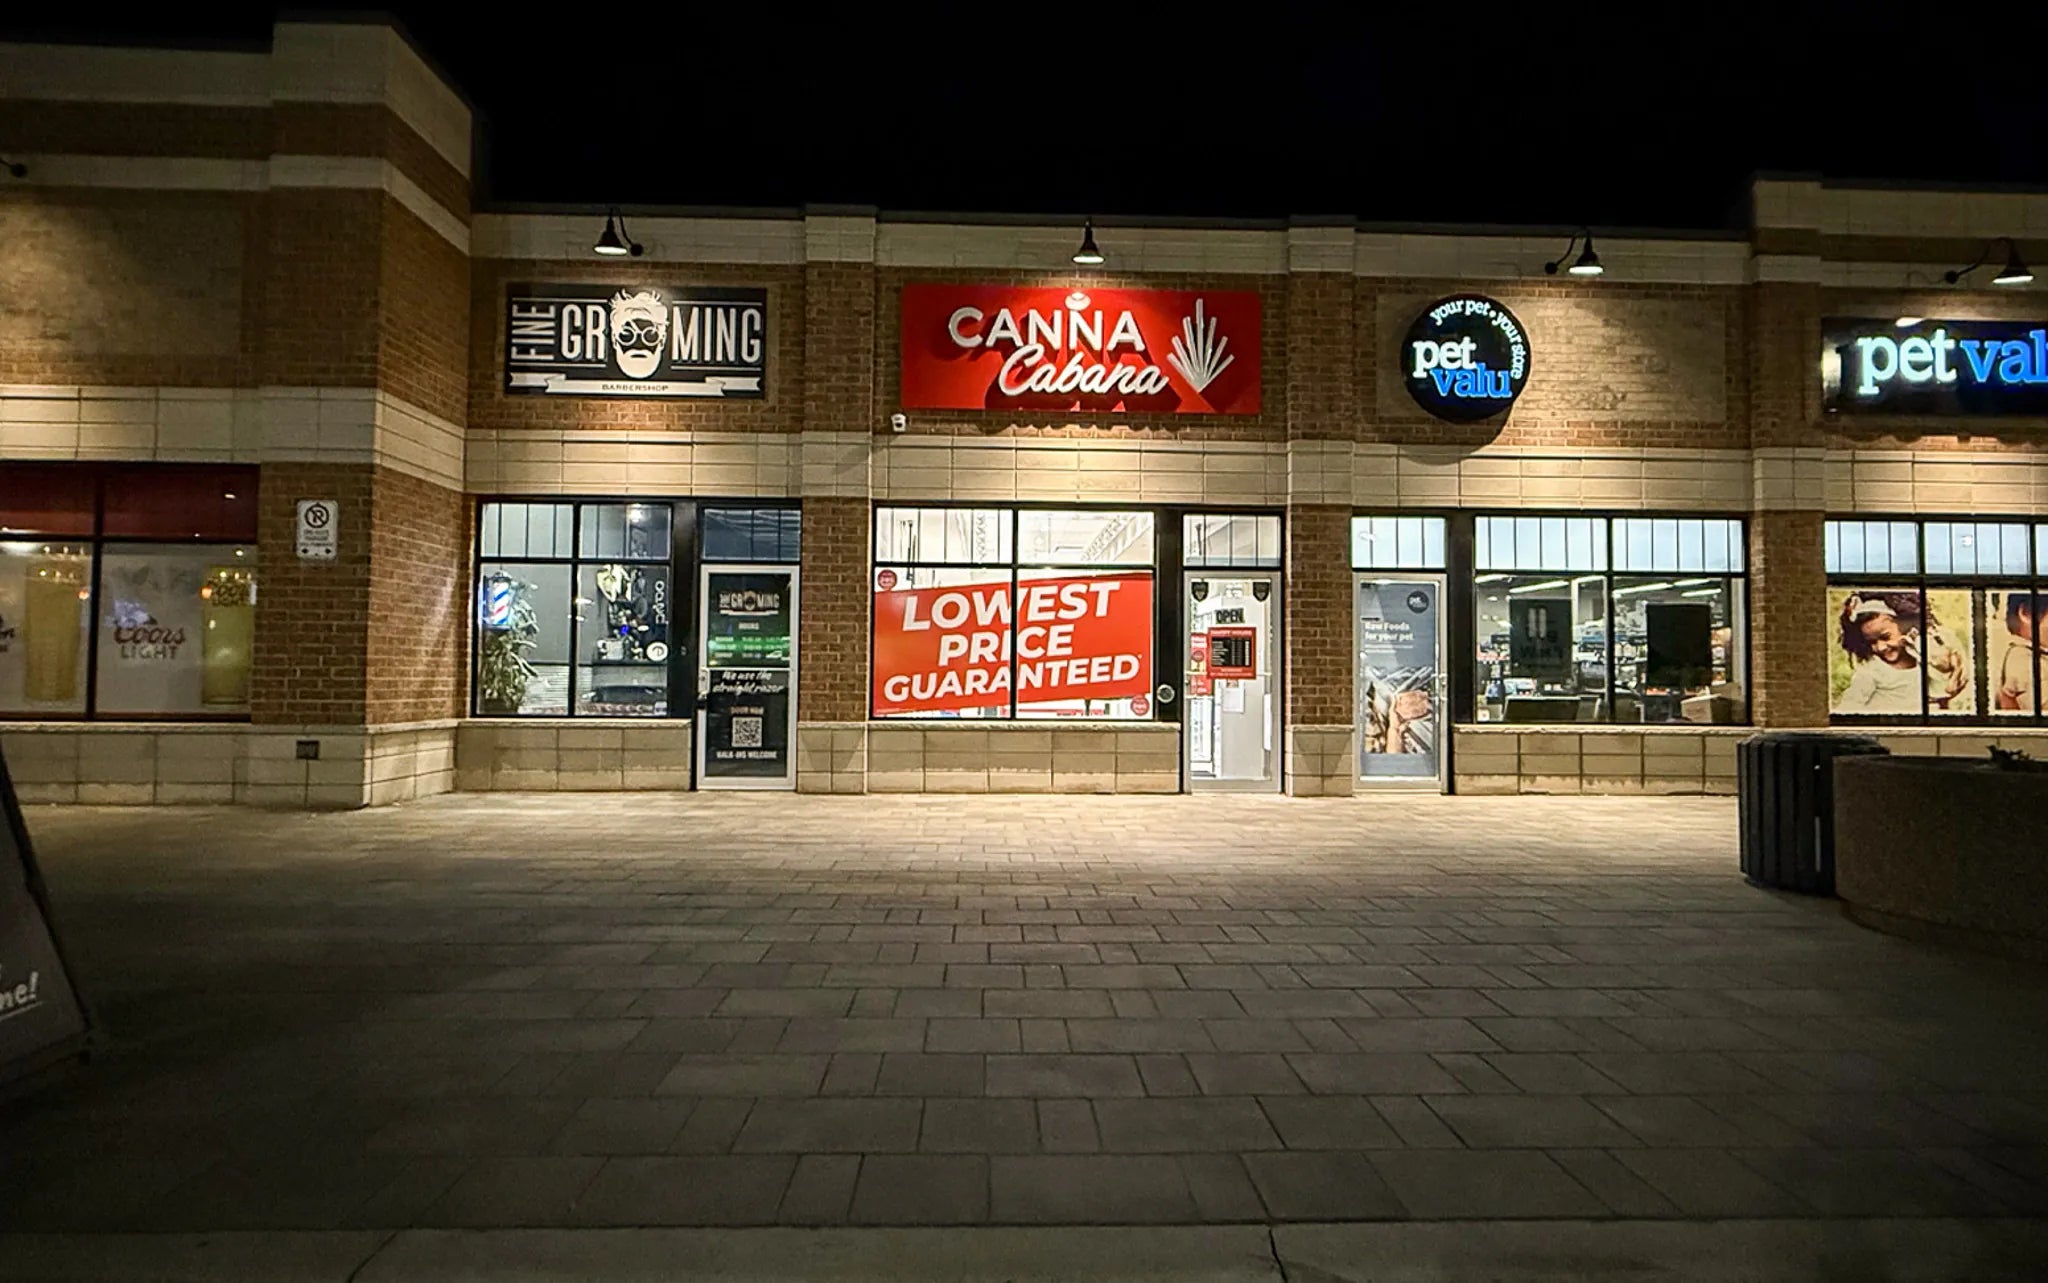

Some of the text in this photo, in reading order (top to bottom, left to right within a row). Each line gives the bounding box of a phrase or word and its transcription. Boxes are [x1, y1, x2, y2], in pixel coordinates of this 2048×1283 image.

[511, 304, 556, 361] FINE
[948, 305, 1146, 352] CANNA
[1429, 299, 1527, 380] your pet your store
[998, 342, 1170, 396] Cabana
[1412, 336, 1477, 378] pet
[1429, 362, 1513, 398] valu
[1856, 328, 2048, 394] pet val
[902, 581, 1121, 632] LOWEST
[1215, 606, 1245, 623] OPEN
[937, 624, 1075, 667] PRICE
